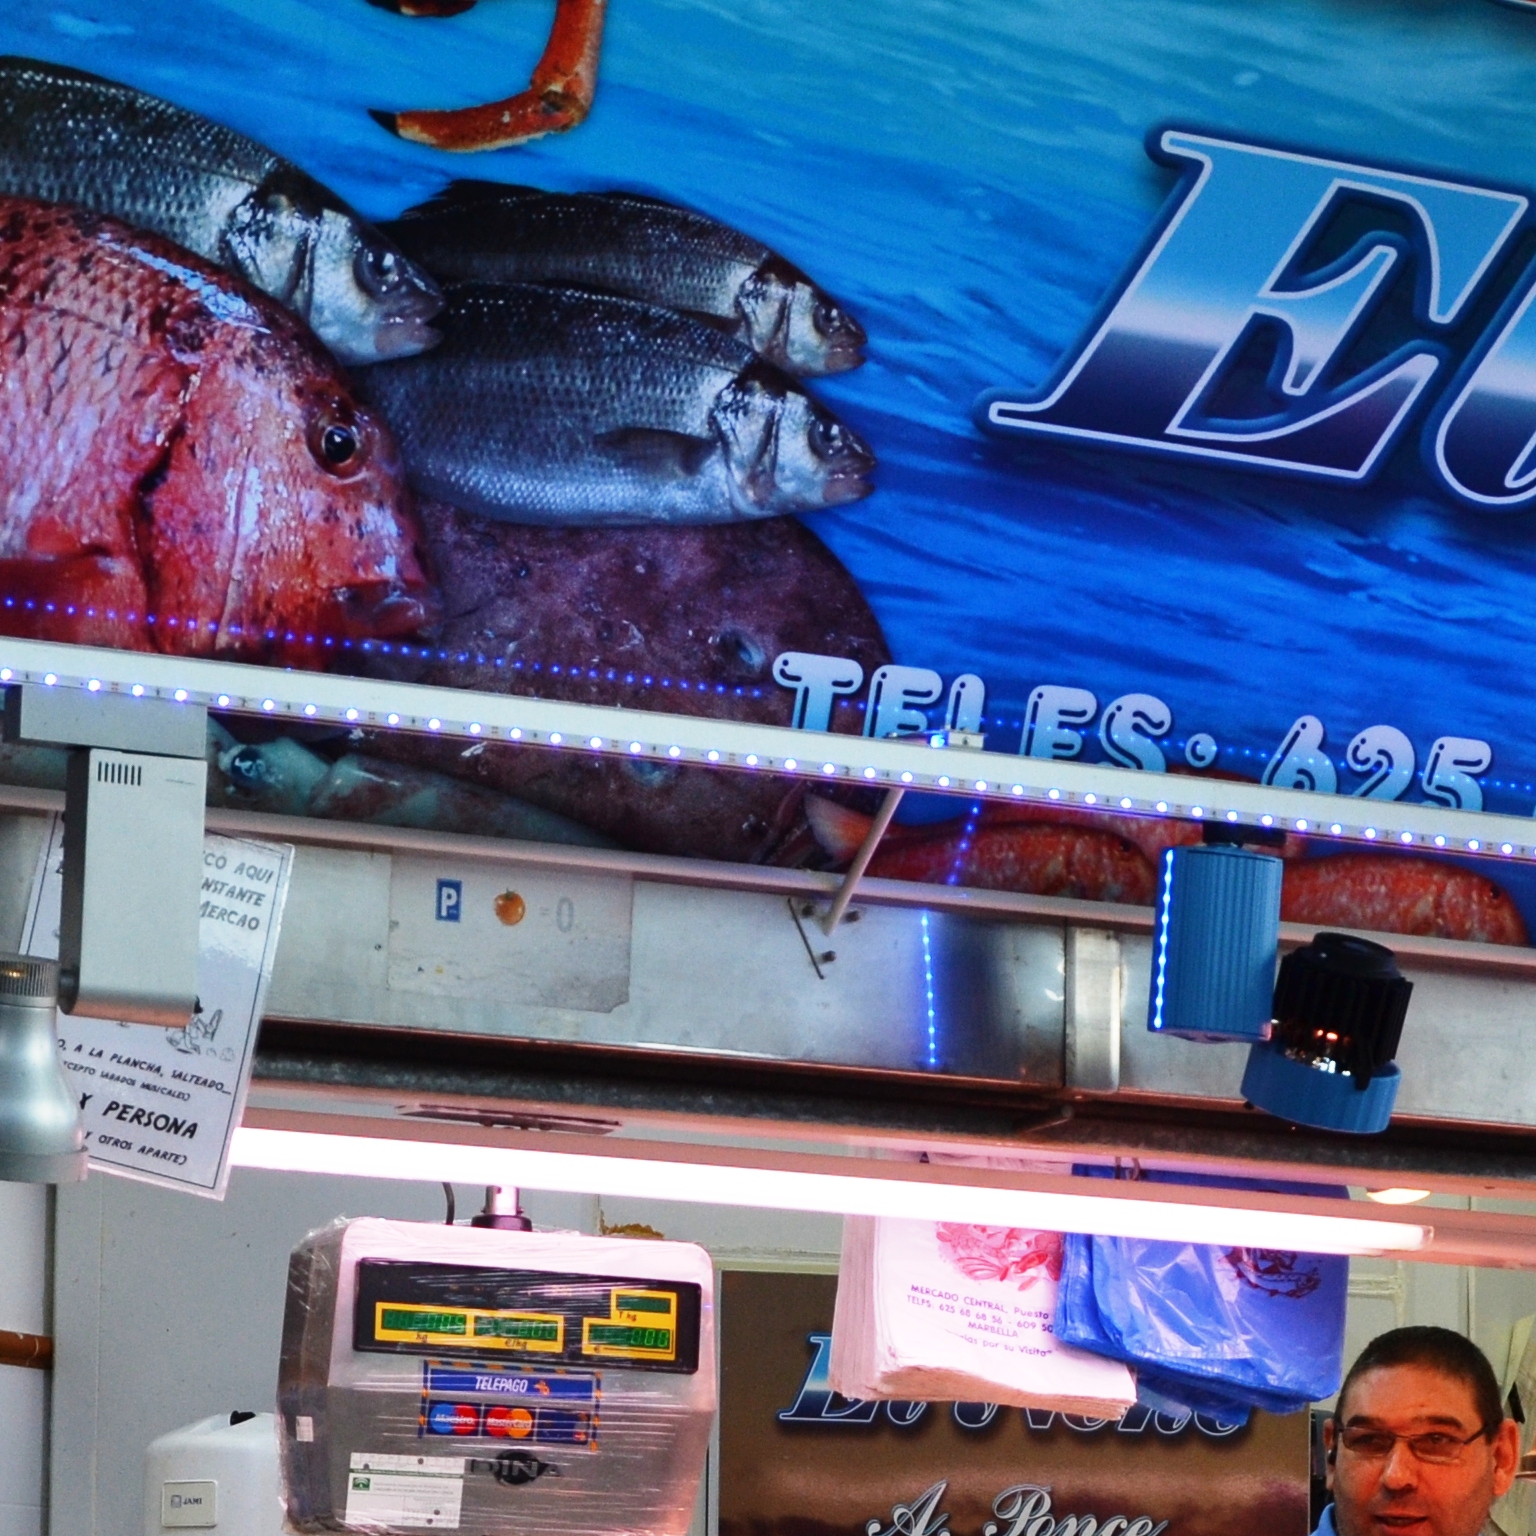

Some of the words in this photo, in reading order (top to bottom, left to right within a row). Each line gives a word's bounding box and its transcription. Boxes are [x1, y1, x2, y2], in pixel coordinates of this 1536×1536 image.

[1263, 714, 1493, 811] 625
[234, 862, 274, 884] AQUI
[201, 877, 266, 908] NSTANTE
[74, 1044, 83, 1053] A
[88, 1047, 103, 1058] LA
[103, 1101, 198, 1139] PERSONA
[99, 1134, 132, 1150] OTROS
[911, 1284, 959, 1302] MERCADO
[1014, 1306, 1049, 1320] Puesto
[939, 1304, 955, 1314] 625
[960, 1308, 970, 1317] 68
[976, 1311, 986, 1321] 68
[992, 1315, 1002, 1324] 56
[1017, 1320, 1036, 1329] 609
[968, 1321, 1018, 1338] MARBELLA
[1004, 1344, 1014, 1352] su
[475, 1376, 528, 1393] TELEPAGO
